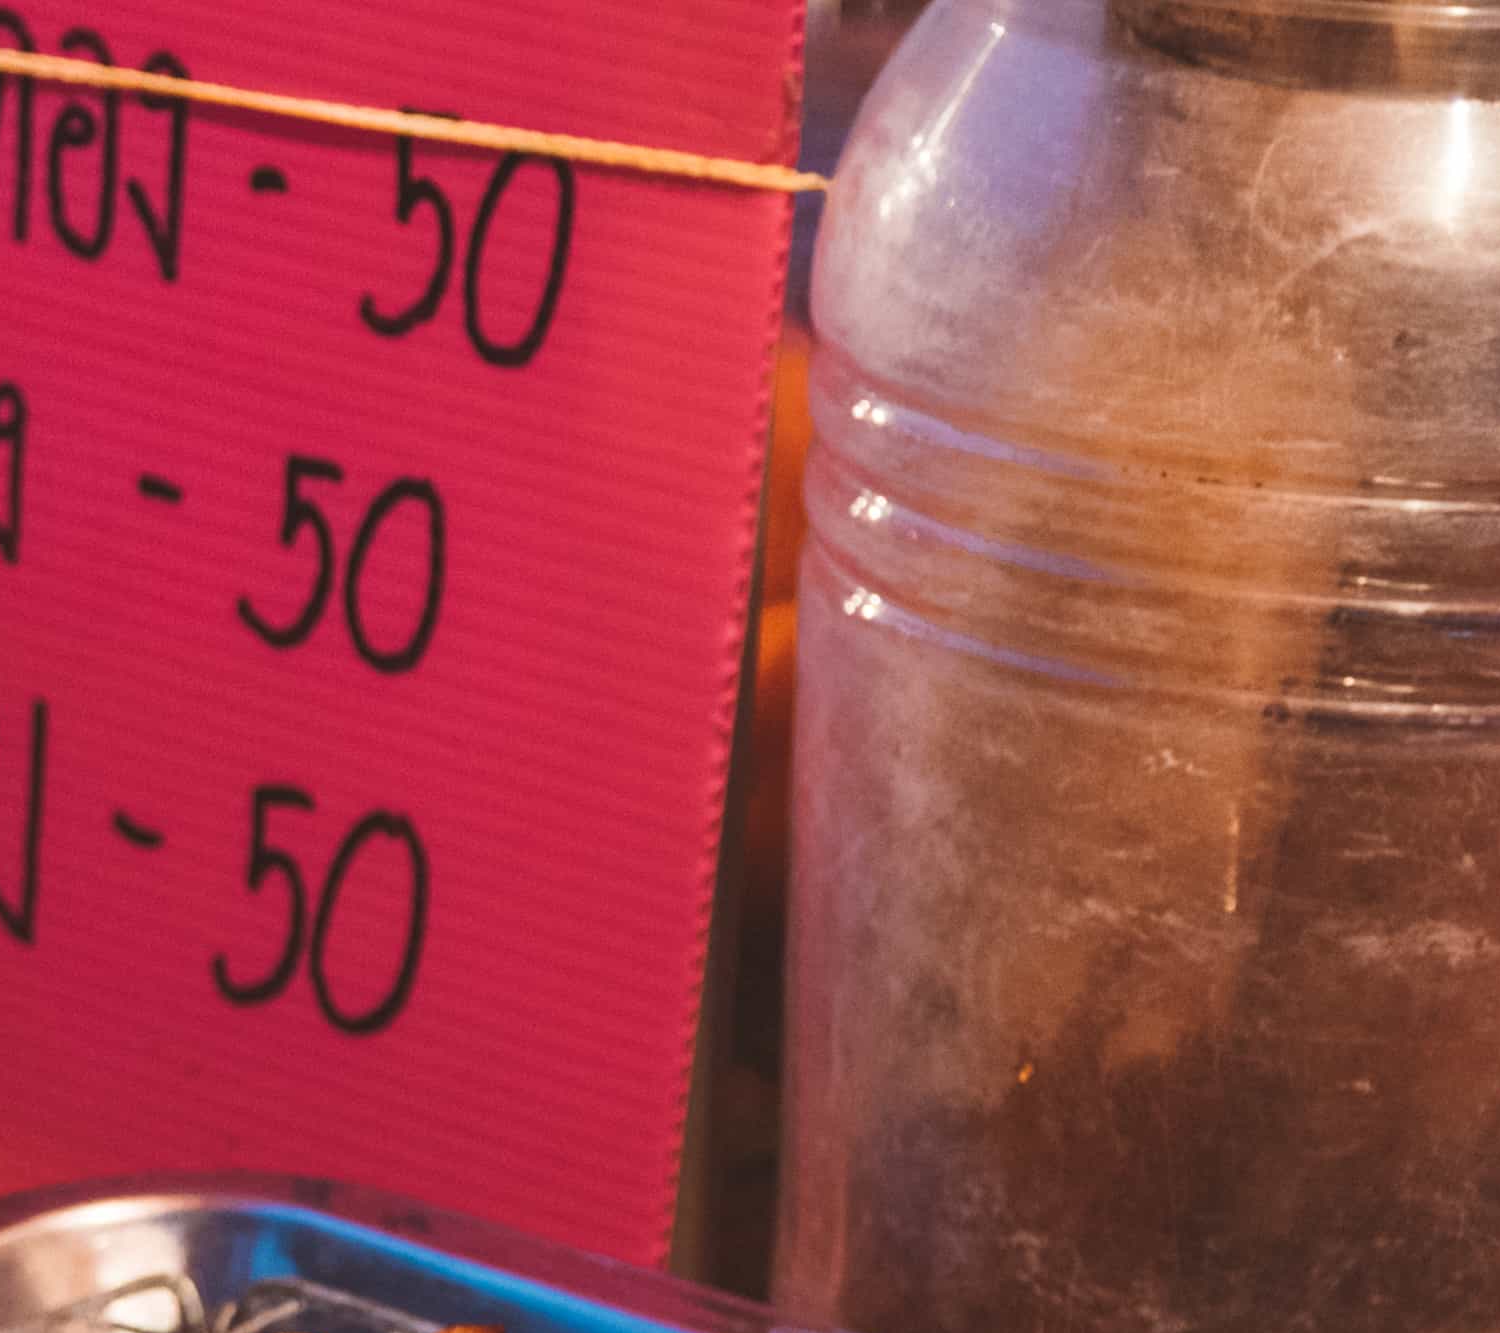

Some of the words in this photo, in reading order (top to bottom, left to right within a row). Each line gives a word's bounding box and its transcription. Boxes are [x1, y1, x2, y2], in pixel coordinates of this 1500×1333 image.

[360, 110, 576, 367] 50
[238, 455, 446, 675] 50
[212, 784, 430, 1037] 50
